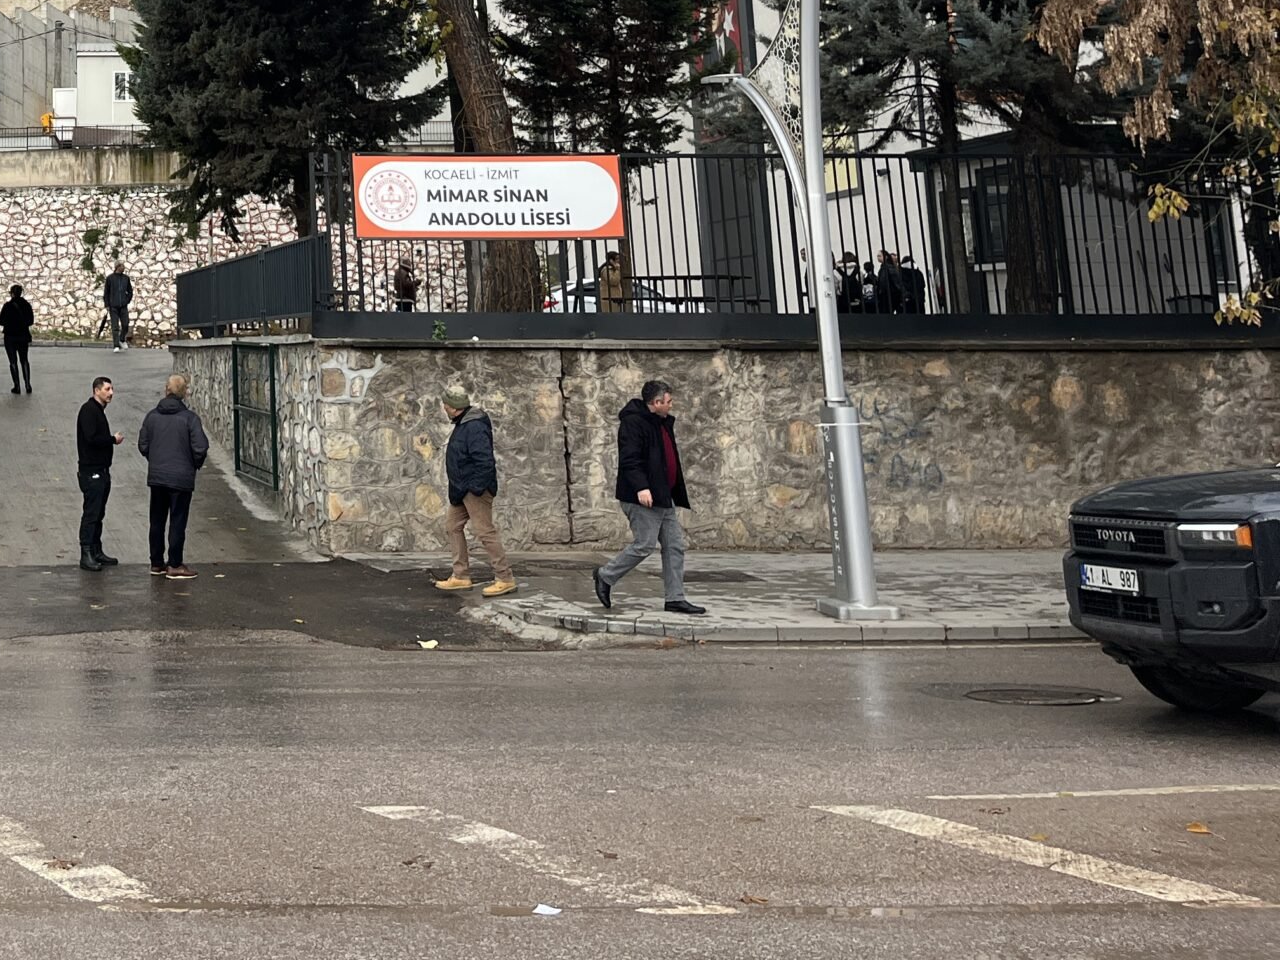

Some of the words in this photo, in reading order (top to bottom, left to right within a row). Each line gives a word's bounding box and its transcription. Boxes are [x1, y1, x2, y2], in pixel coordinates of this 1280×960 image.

[424, 168, 476, 180] KOCAELİ
[486, 167, 520, 180] İZMİT
[426, 185, 490, 203] MİMAR
[493, 185, 549, 203] SİNAN
[428, 212, 516, 226] ANADOLU
[521, 208, 571, 226] LİSESİ
[1096, 529, 1136, 543] TOYOTA
[1101, 568, 1113, 586] AL
[1120, 570, 1136, 589] 987
